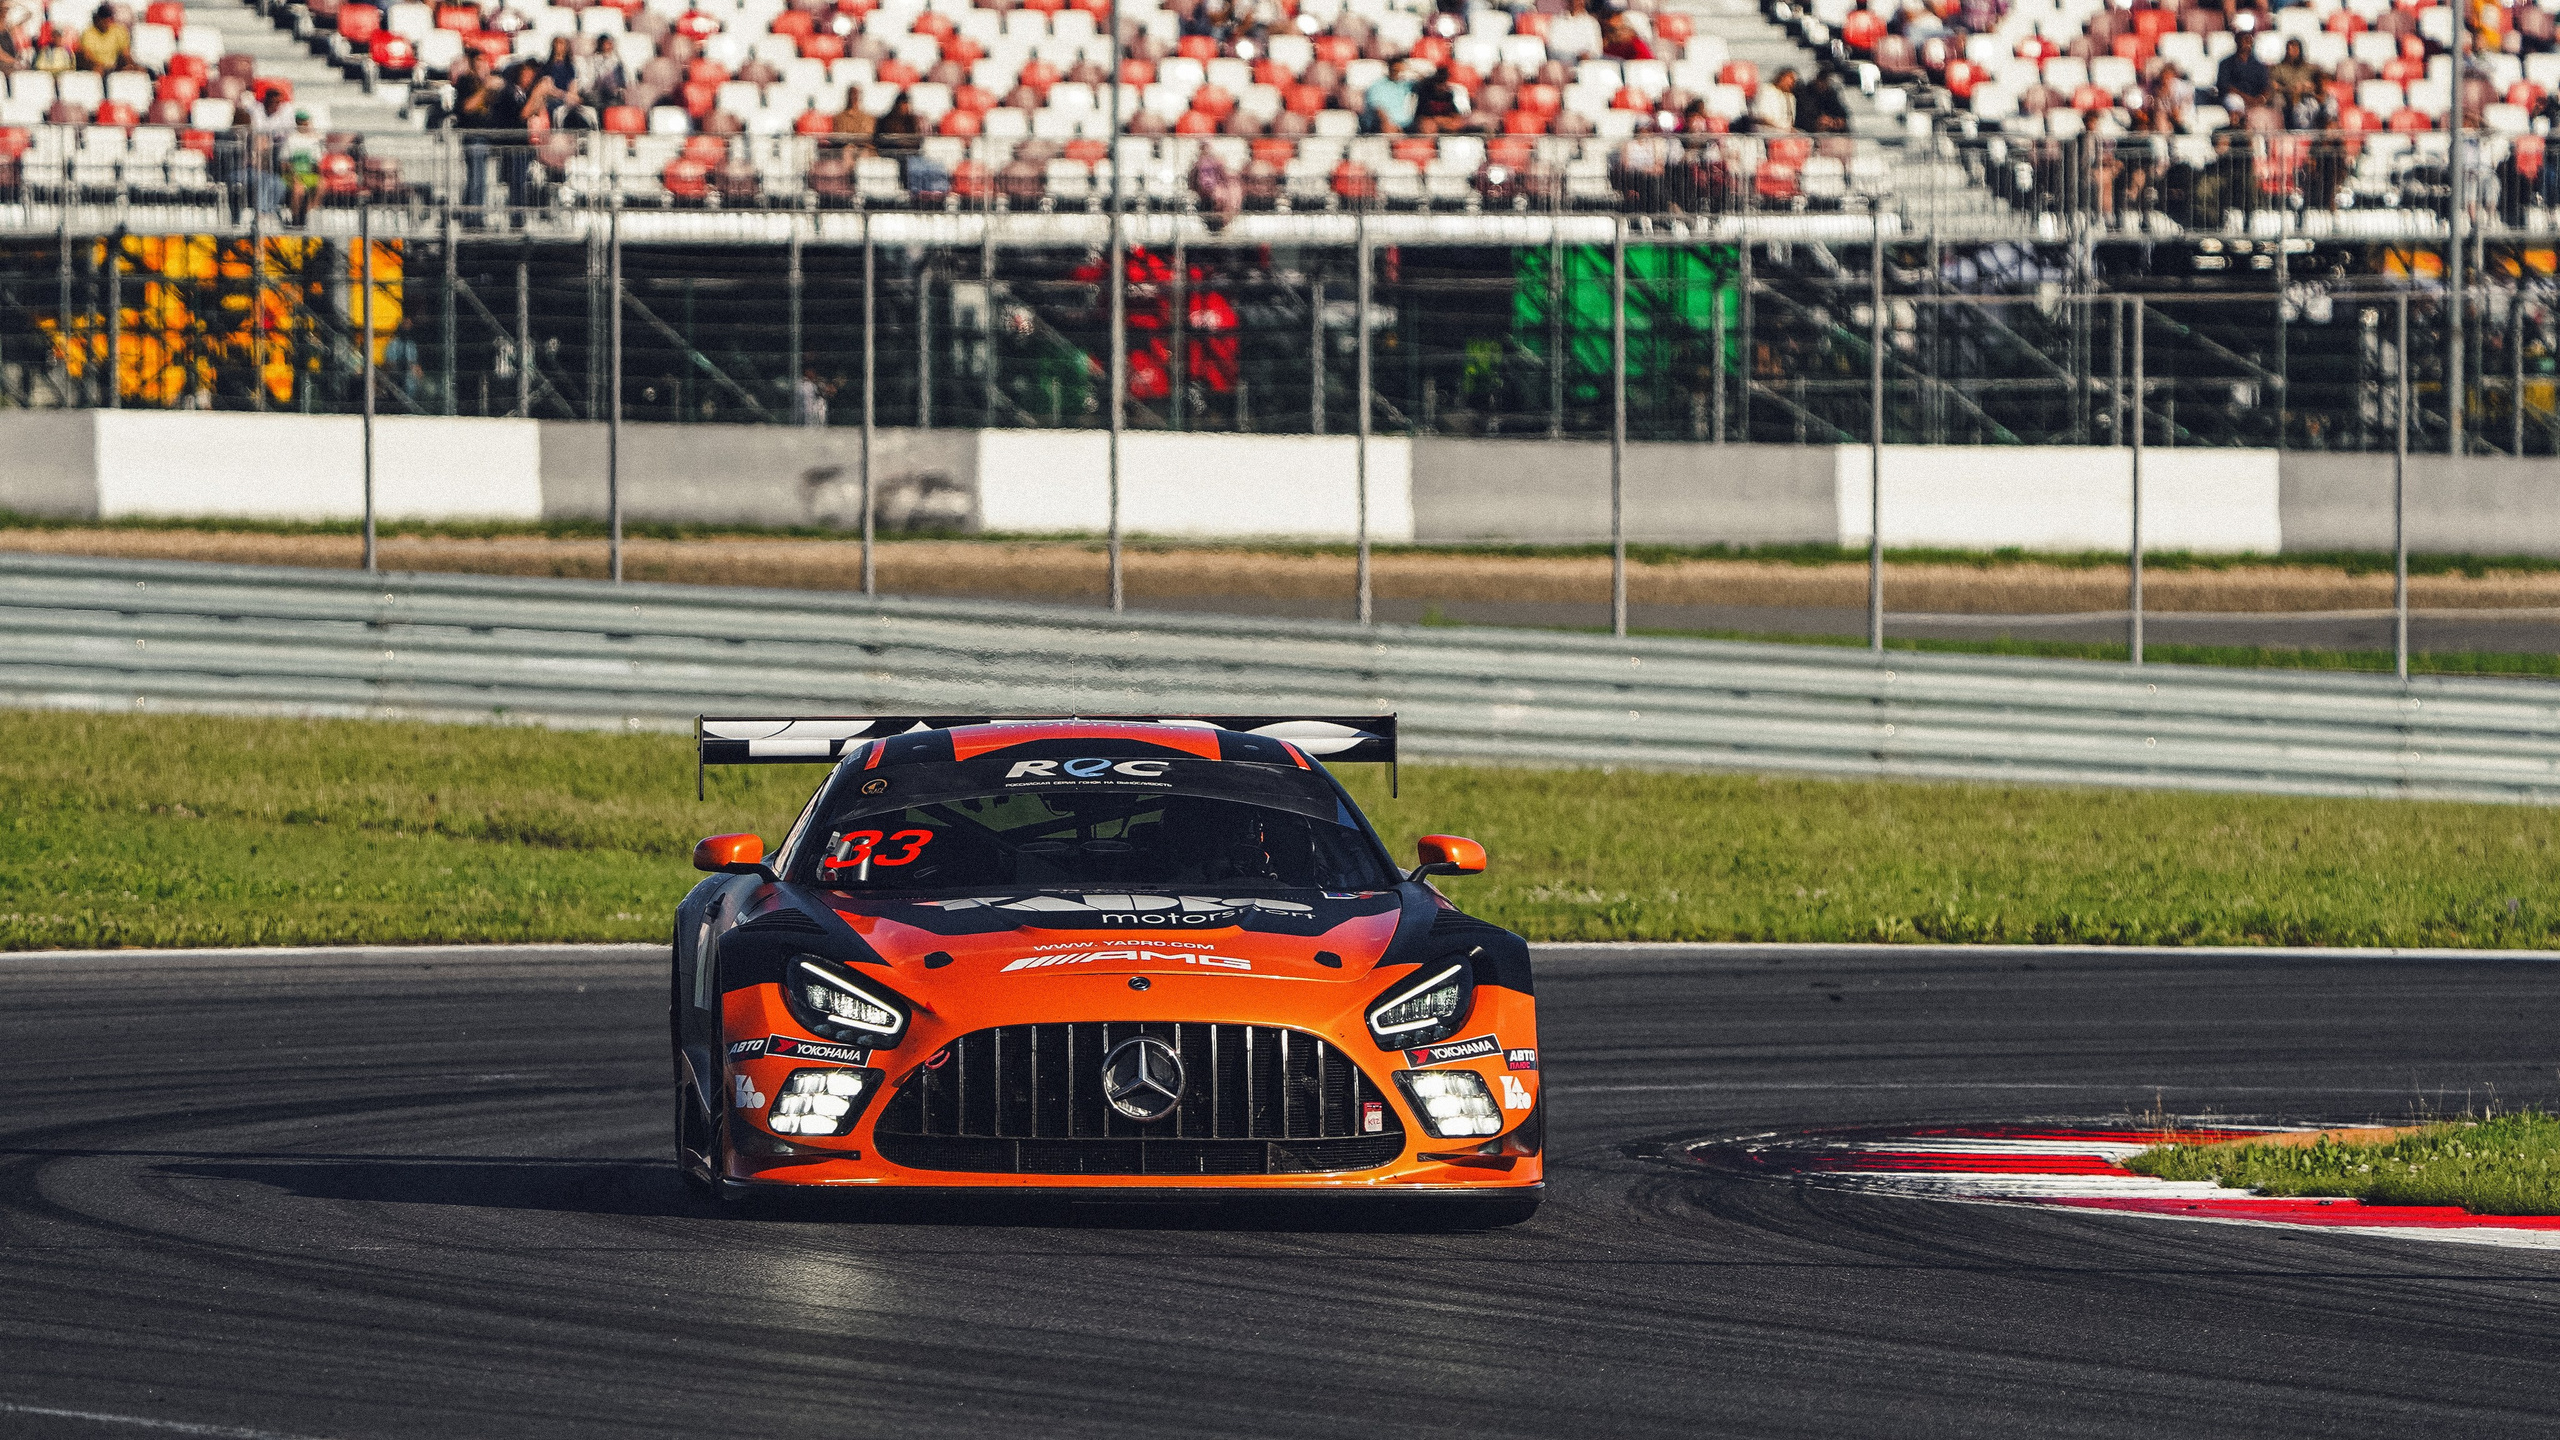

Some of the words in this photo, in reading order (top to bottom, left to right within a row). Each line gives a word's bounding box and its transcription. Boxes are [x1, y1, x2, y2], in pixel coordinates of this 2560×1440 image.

[824, 829, 934, 868] 33
[1102, 907, 1316, 925] motorsport
[797, 1043, 861, 1061] YOKOHAMA
[1430, 1040, 1495, 1059] YOKOHAMA
[1509, 1049, 1535, 1062] АВТО
